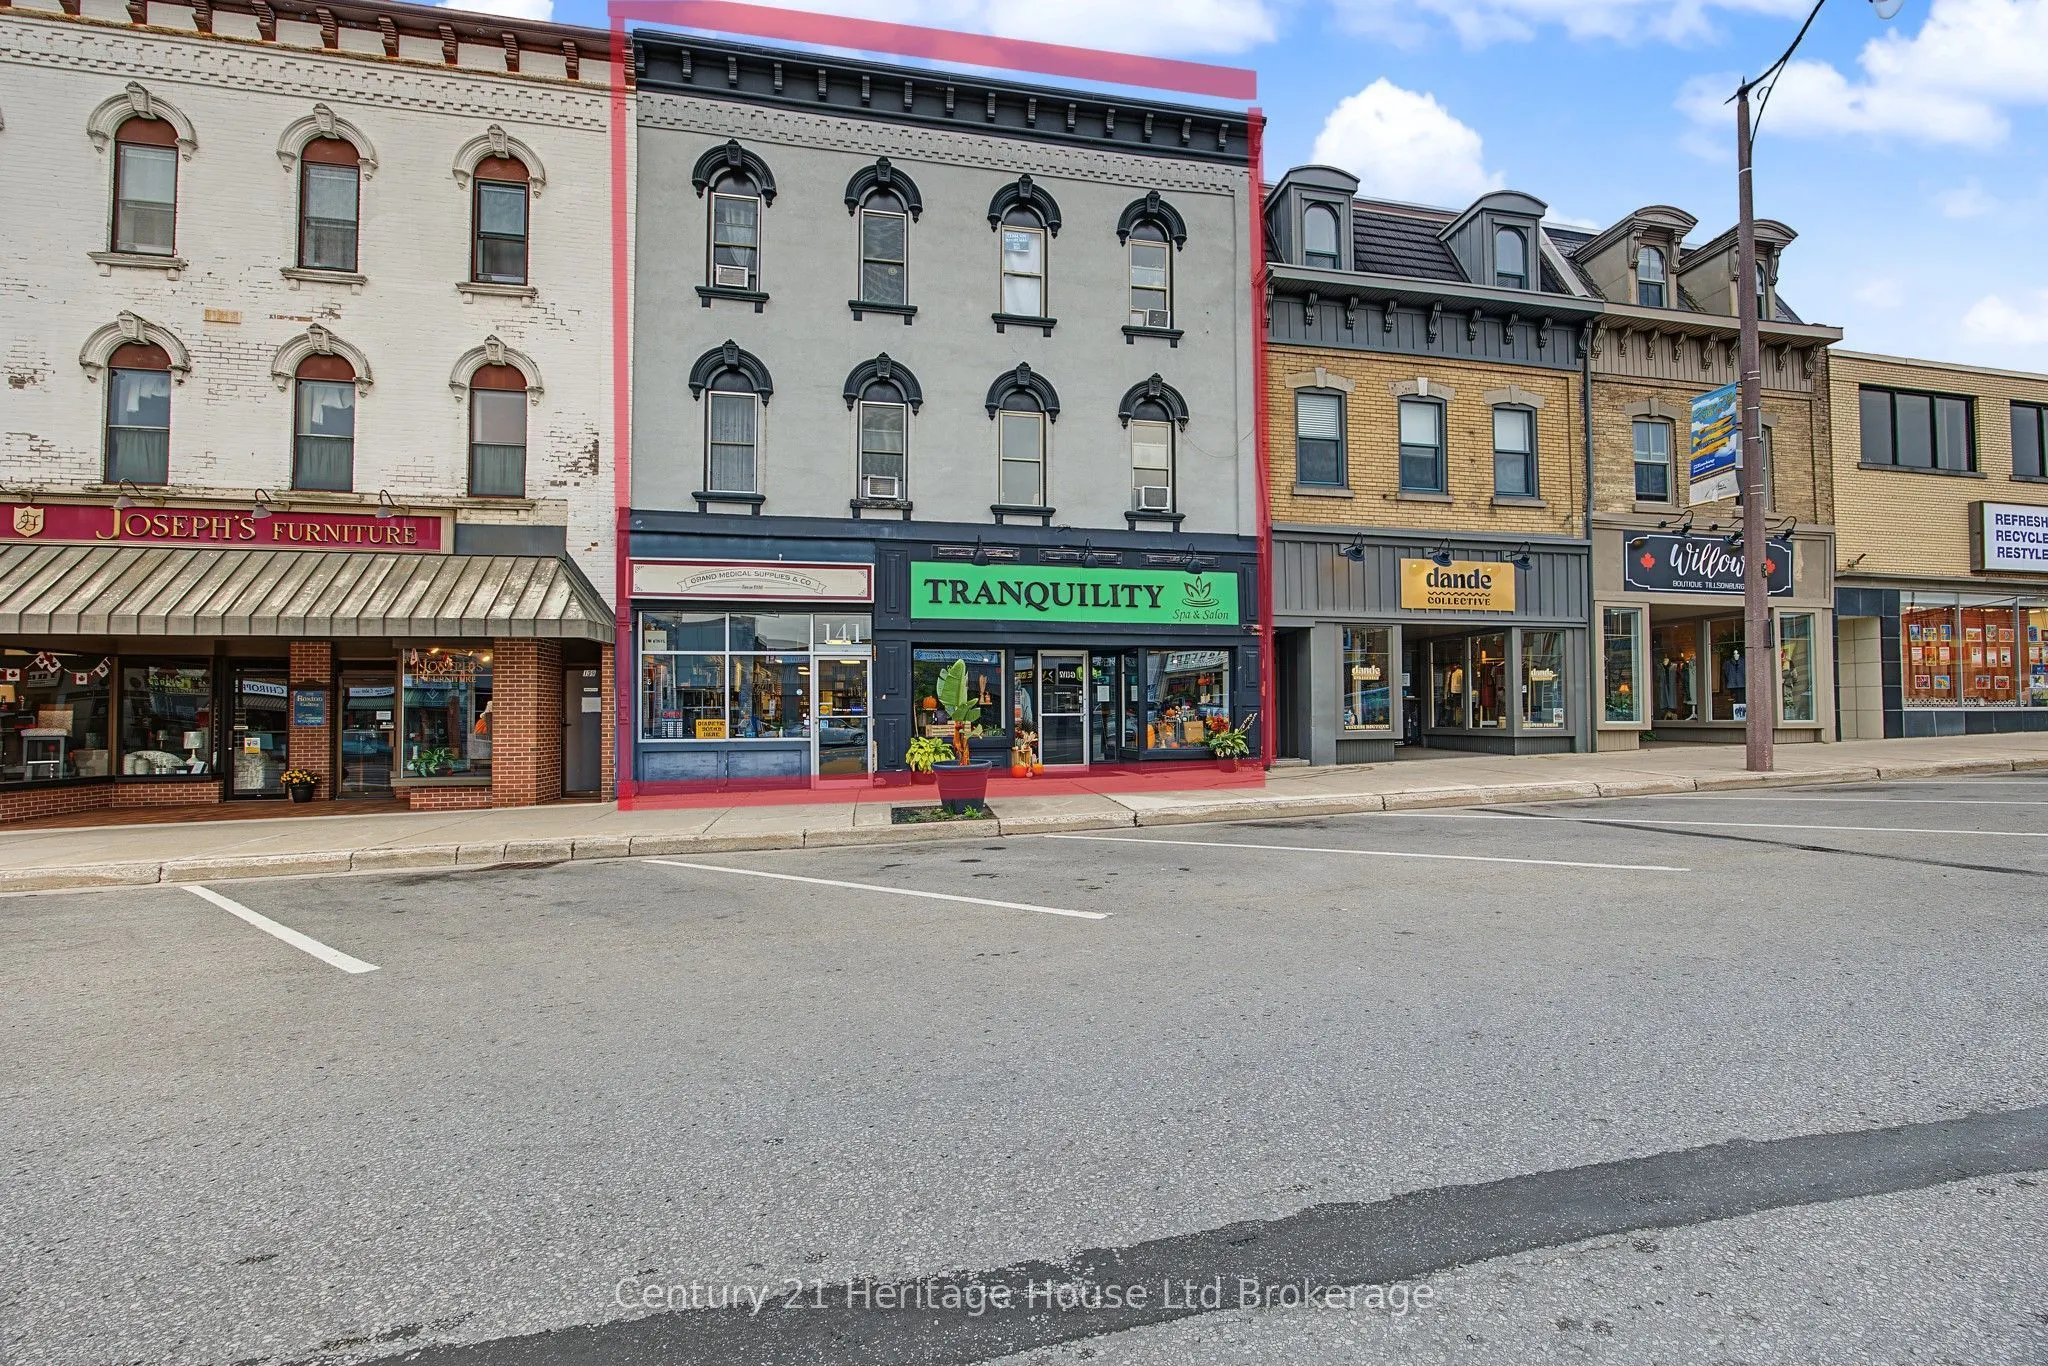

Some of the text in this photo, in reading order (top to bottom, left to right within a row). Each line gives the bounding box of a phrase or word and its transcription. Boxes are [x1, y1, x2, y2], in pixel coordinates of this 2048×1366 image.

[96, 507, 418, 544] JOSEPH'S FURNITURE
[1995, 513, 2048, 527] REFRESH
[1996, 530, 2048, 543] RECYCLE
[1997, 546, 2048, 560] RESTYLE
[690, 573, 717, 584] GRAND
[719, 570, 751, 578] MEDICAL
[754, 570, 790, 581] SUPPLIES
[800, 578, 812, 586] CO
[1426, 567, 1492, 589] dande
[1672, 580, 1745, 590] BOUTIQUE TILLSONBURG
[923, 578, 1165, 612] TRANQUILITY
[1427, 596, 1491, 606] COLLECTIVE
[1173, 609, 1229, 621] Spa & Salon
[823, 623, 863, 644] 141
